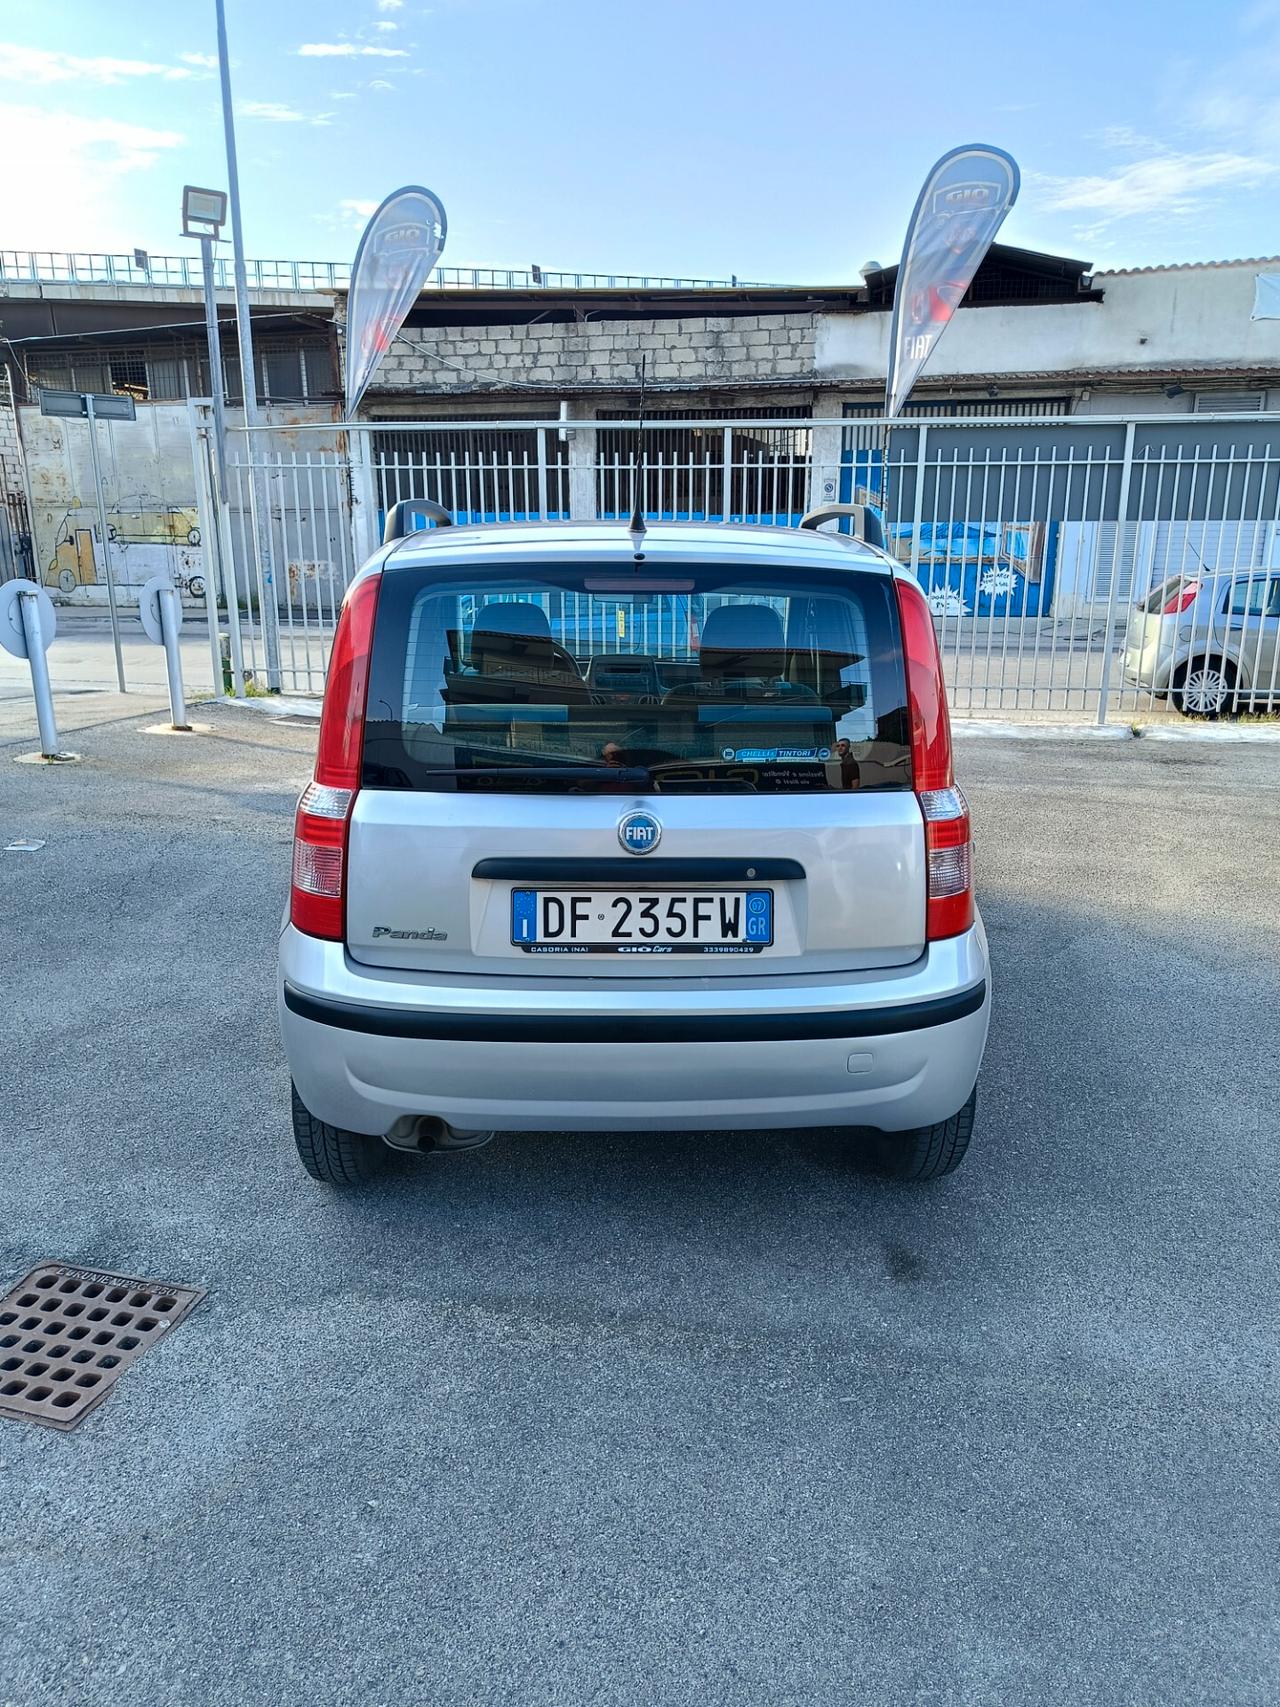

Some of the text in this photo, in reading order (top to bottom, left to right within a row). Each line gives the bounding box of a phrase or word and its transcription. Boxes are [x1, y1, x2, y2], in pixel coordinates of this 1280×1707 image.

[904, 335, 933, 360] FIAT
[626, 826, 653, 840] FIAT
[543, 896, 592, 938] DF
[611, 896, 741, 938] 235FW
[748, 917, 766, 935] GR
[372, 926, 448, 941] Panda
[652, 945, 673, 953] Cars
